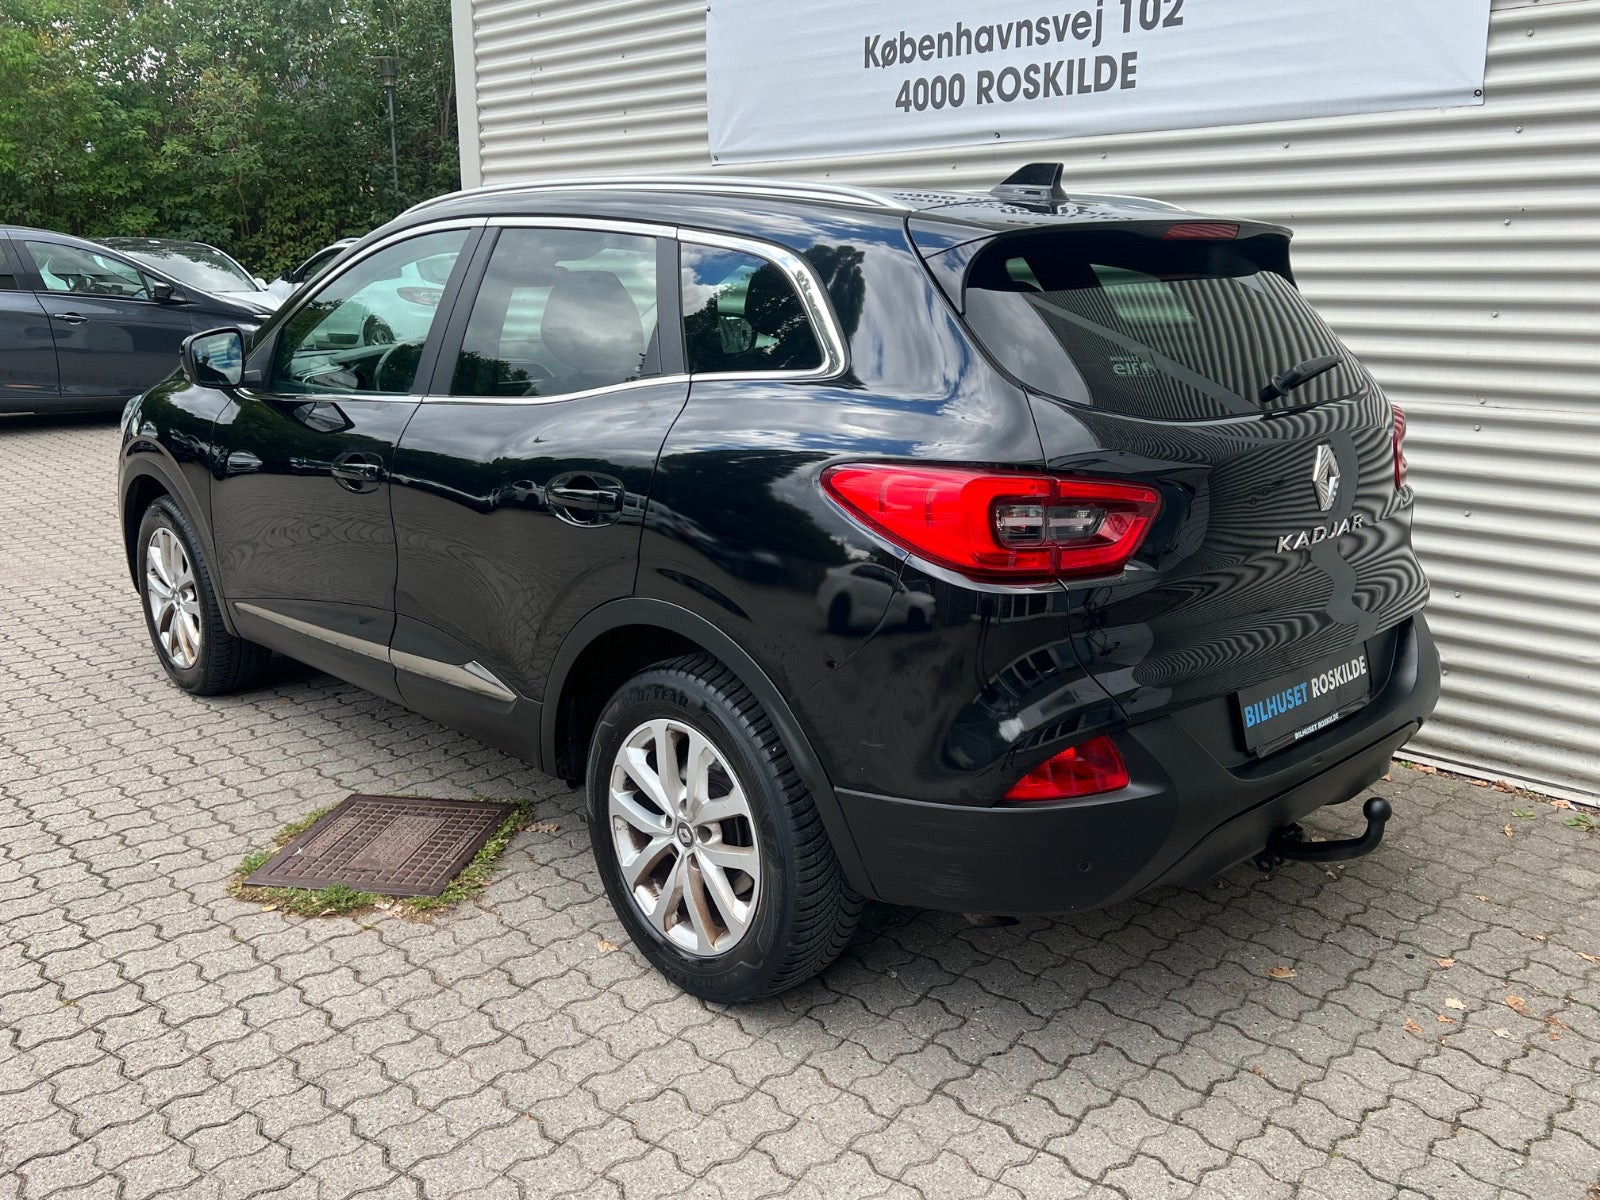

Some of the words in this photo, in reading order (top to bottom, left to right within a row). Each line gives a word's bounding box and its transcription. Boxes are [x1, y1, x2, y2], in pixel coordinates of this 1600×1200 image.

[864, 0, 1103, 69] Københavnsvej
[1119, 0, 1184, 33] 102
[895, 73, 965, 113] 4000
[976, 51, 1138, 105] ROSKILDE
[1275, 513, 1364, 554] KADJAR
[1244, 682, 1308, 728] BILHUSET
[1310, 655, 1367, 698] ROSKILDE
[1294, 723, 1318, 740] BILHUSET
[1317, 712, 1339, 730] ROSKILDE
